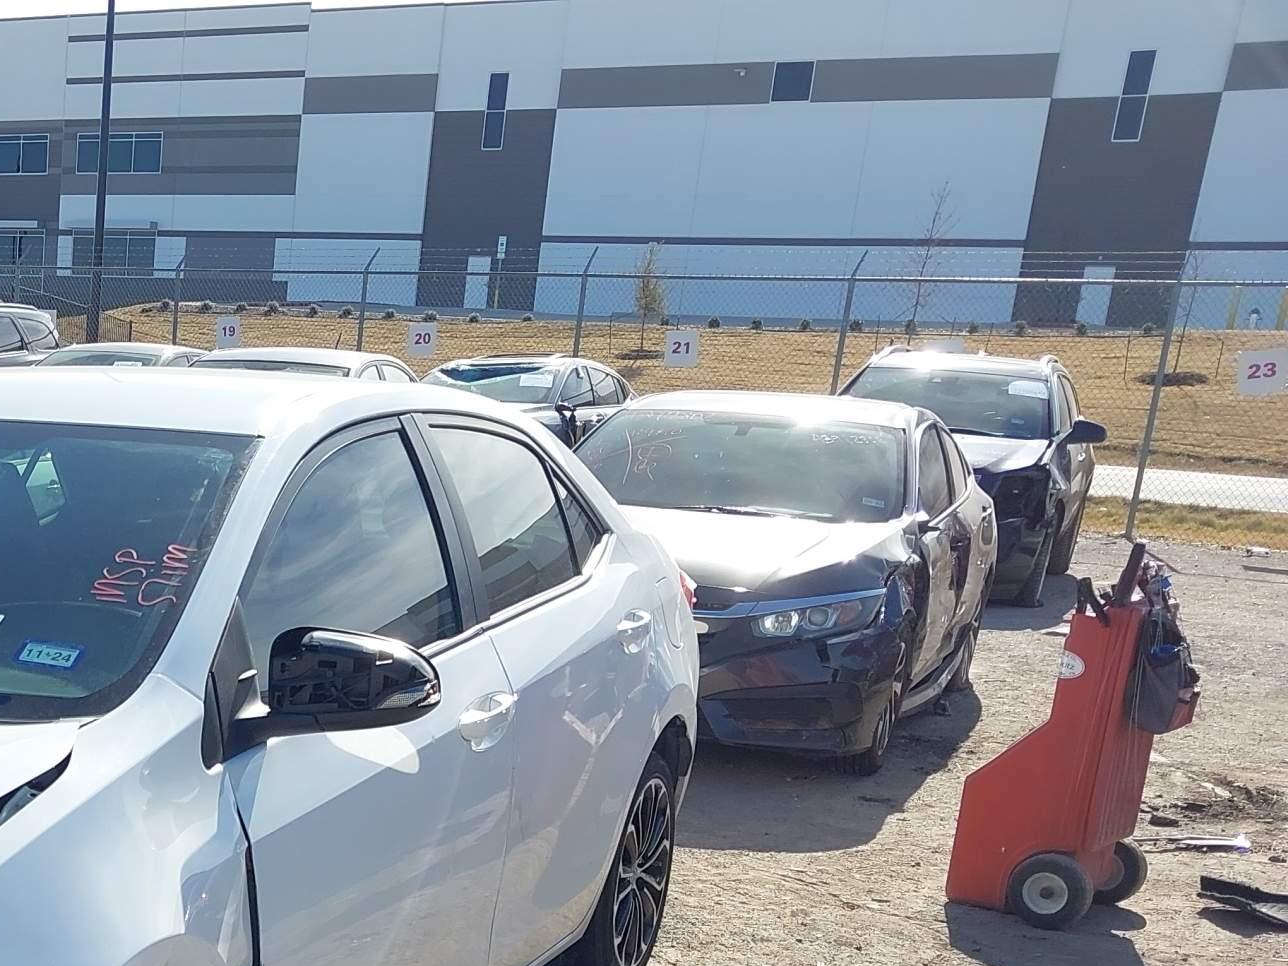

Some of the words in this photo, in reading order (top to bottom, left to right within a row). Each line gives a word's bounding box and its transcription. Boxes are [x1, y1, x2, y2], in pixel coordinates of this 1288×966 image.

[222, 325, 236, 337] 19
[414, 332, 431, 345] 20
[671, 341, 690, 355] 21
[1247, 362, 1277, 380] 23
